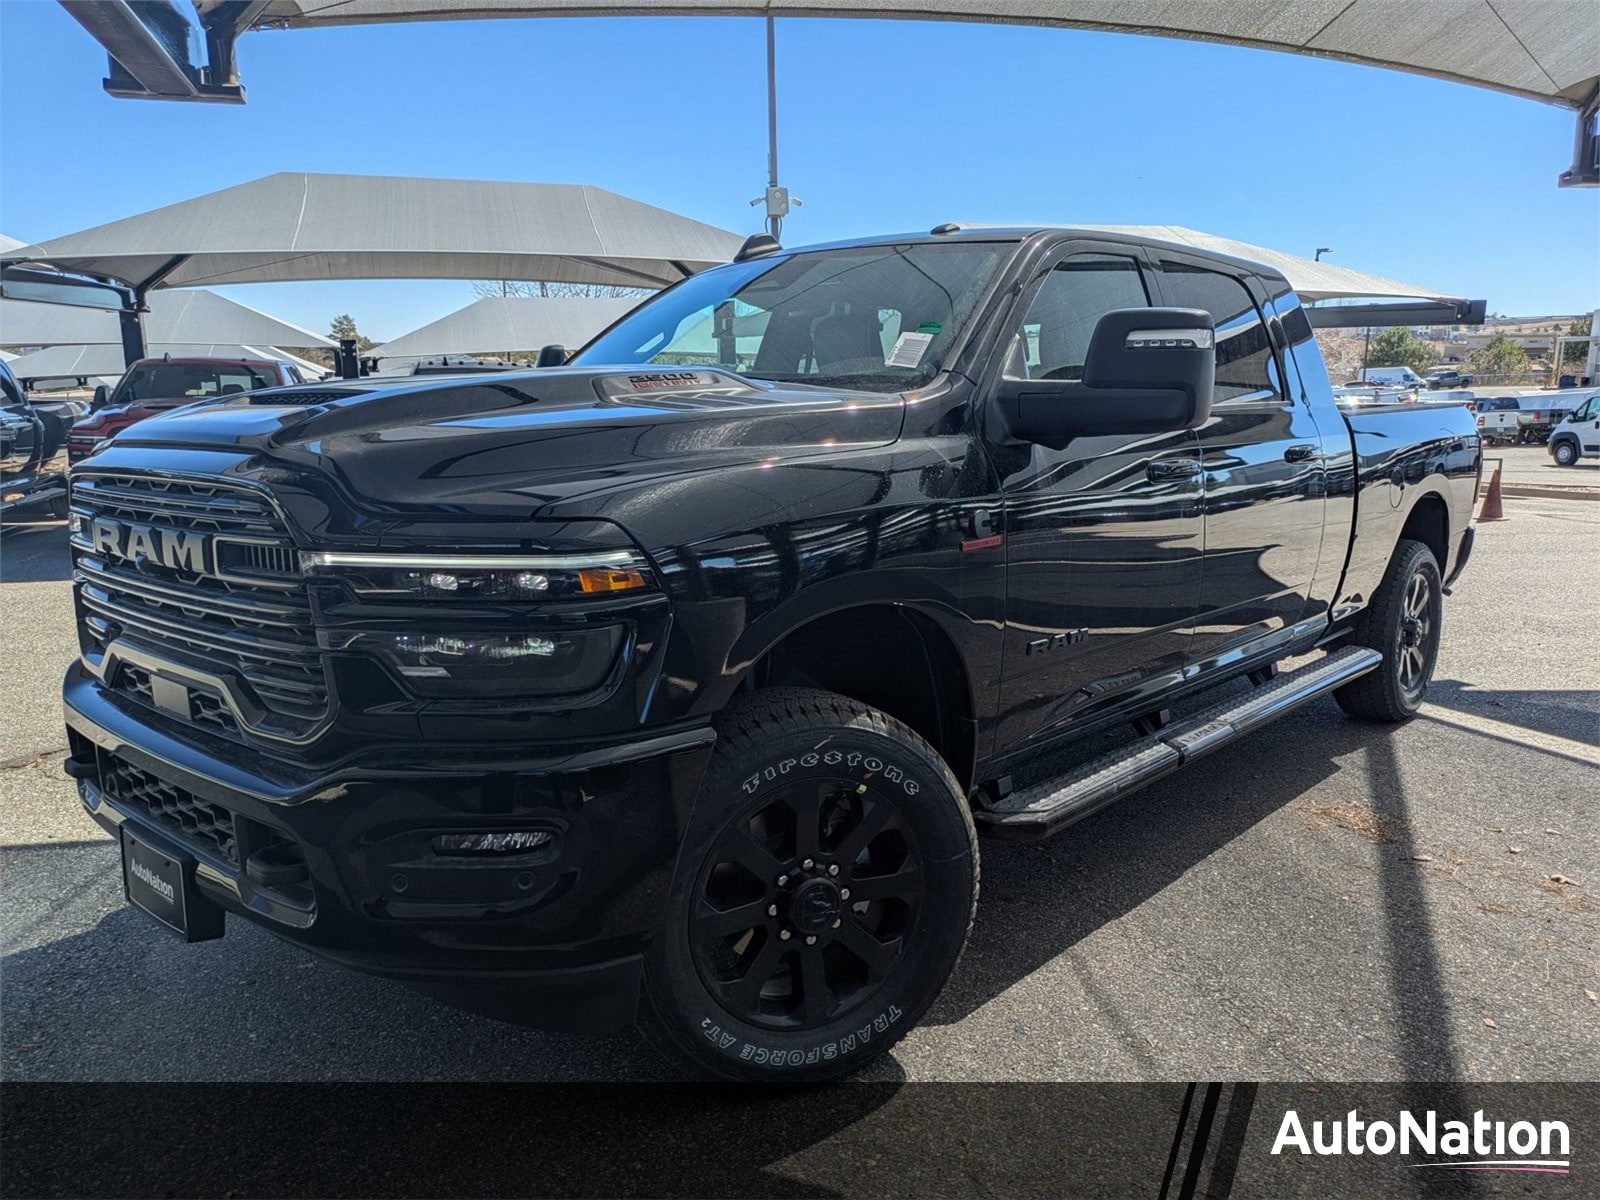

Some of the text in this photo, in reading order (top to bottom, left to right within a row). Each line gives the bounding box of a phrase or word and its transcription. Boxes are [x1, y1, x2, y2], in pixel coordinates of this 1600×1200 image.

[94, 517, 208, 575] RAM
[1026, 627, 1089, 657] RAM
[743, 751, 919, 796] Firestone
[131, 858, 174, 899] AutoNation
[739, 1005, 902, 1066] TRANSFORCE
